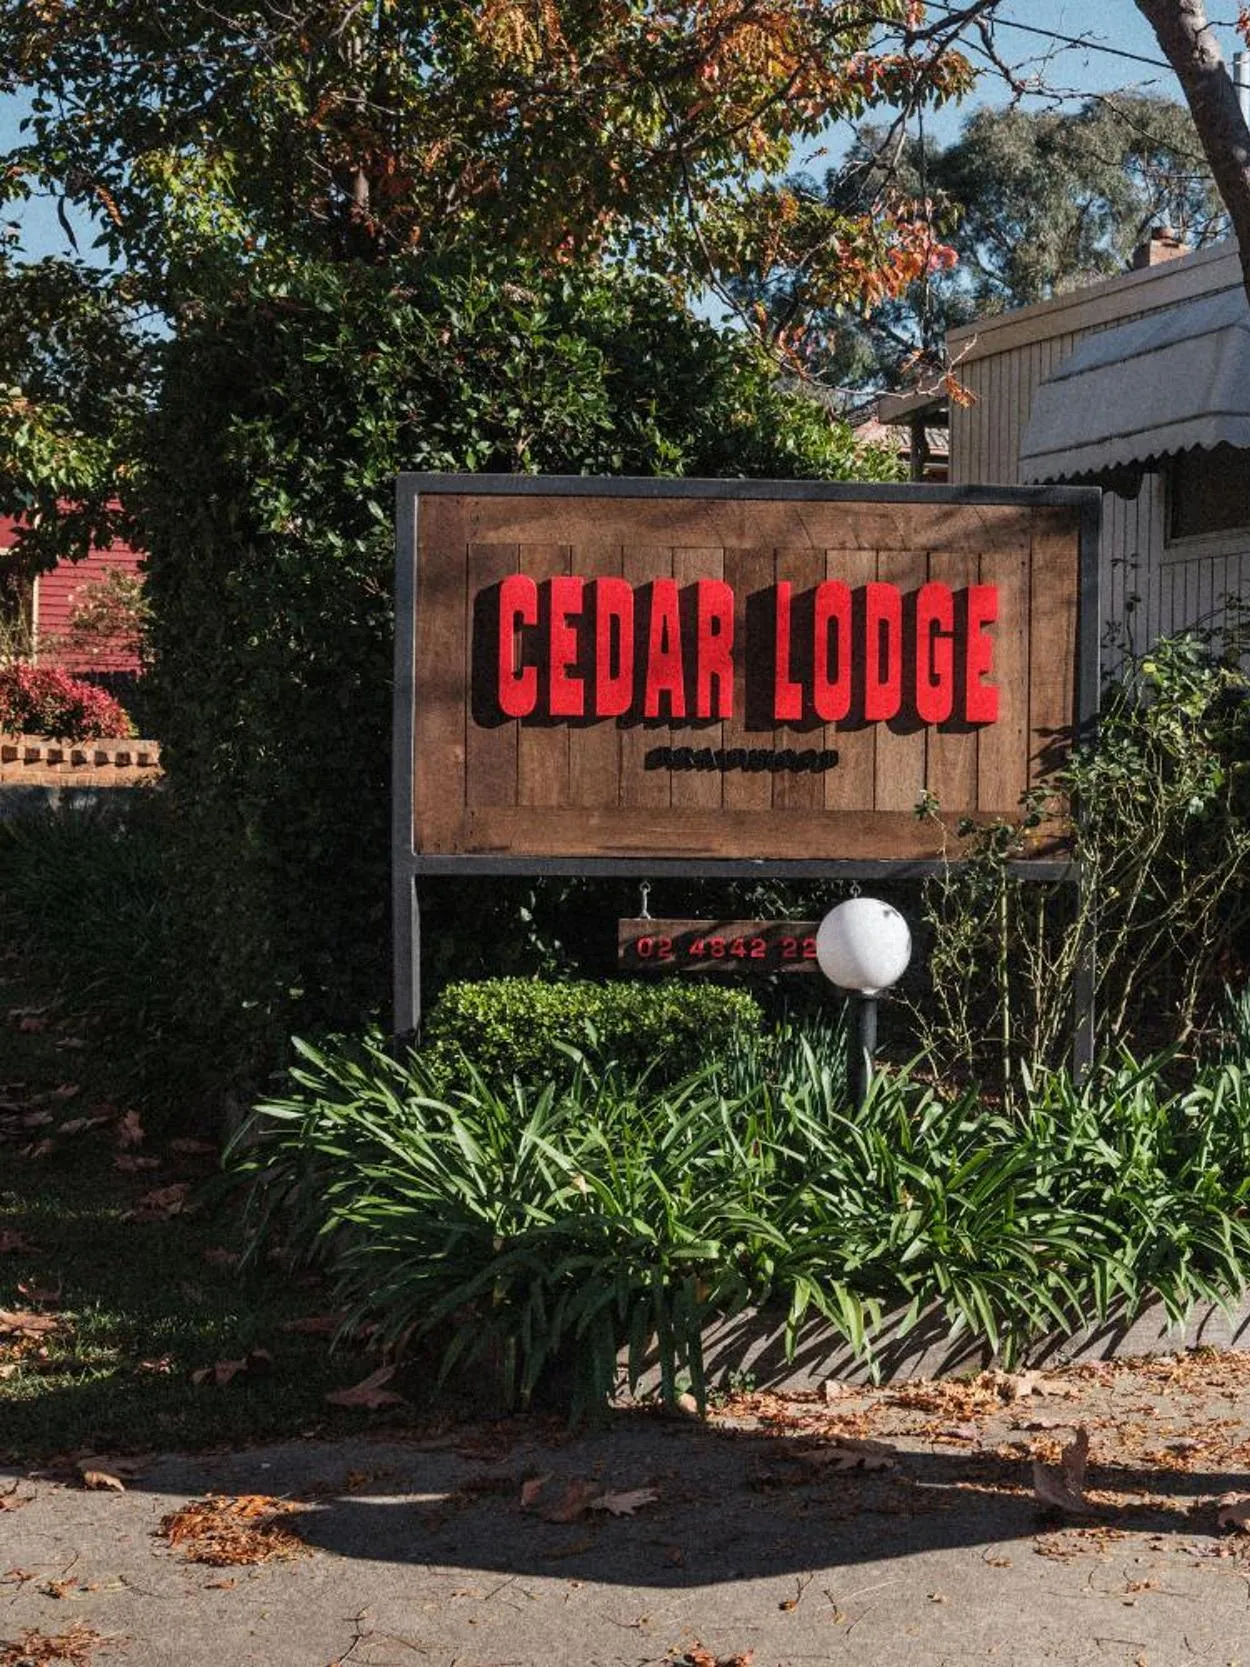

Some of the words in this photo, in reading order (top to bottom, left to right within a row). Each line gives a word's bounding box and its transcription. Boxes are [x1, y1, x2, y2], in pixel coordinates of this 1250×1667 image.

[499, 573, 735, 718] CEDAR
[774, 579, 1000, 723] LODGE
[637, 936, 673, 958] 02
[689, 936, 766, 958] 4842
[781, 936, 818, 959] 22
